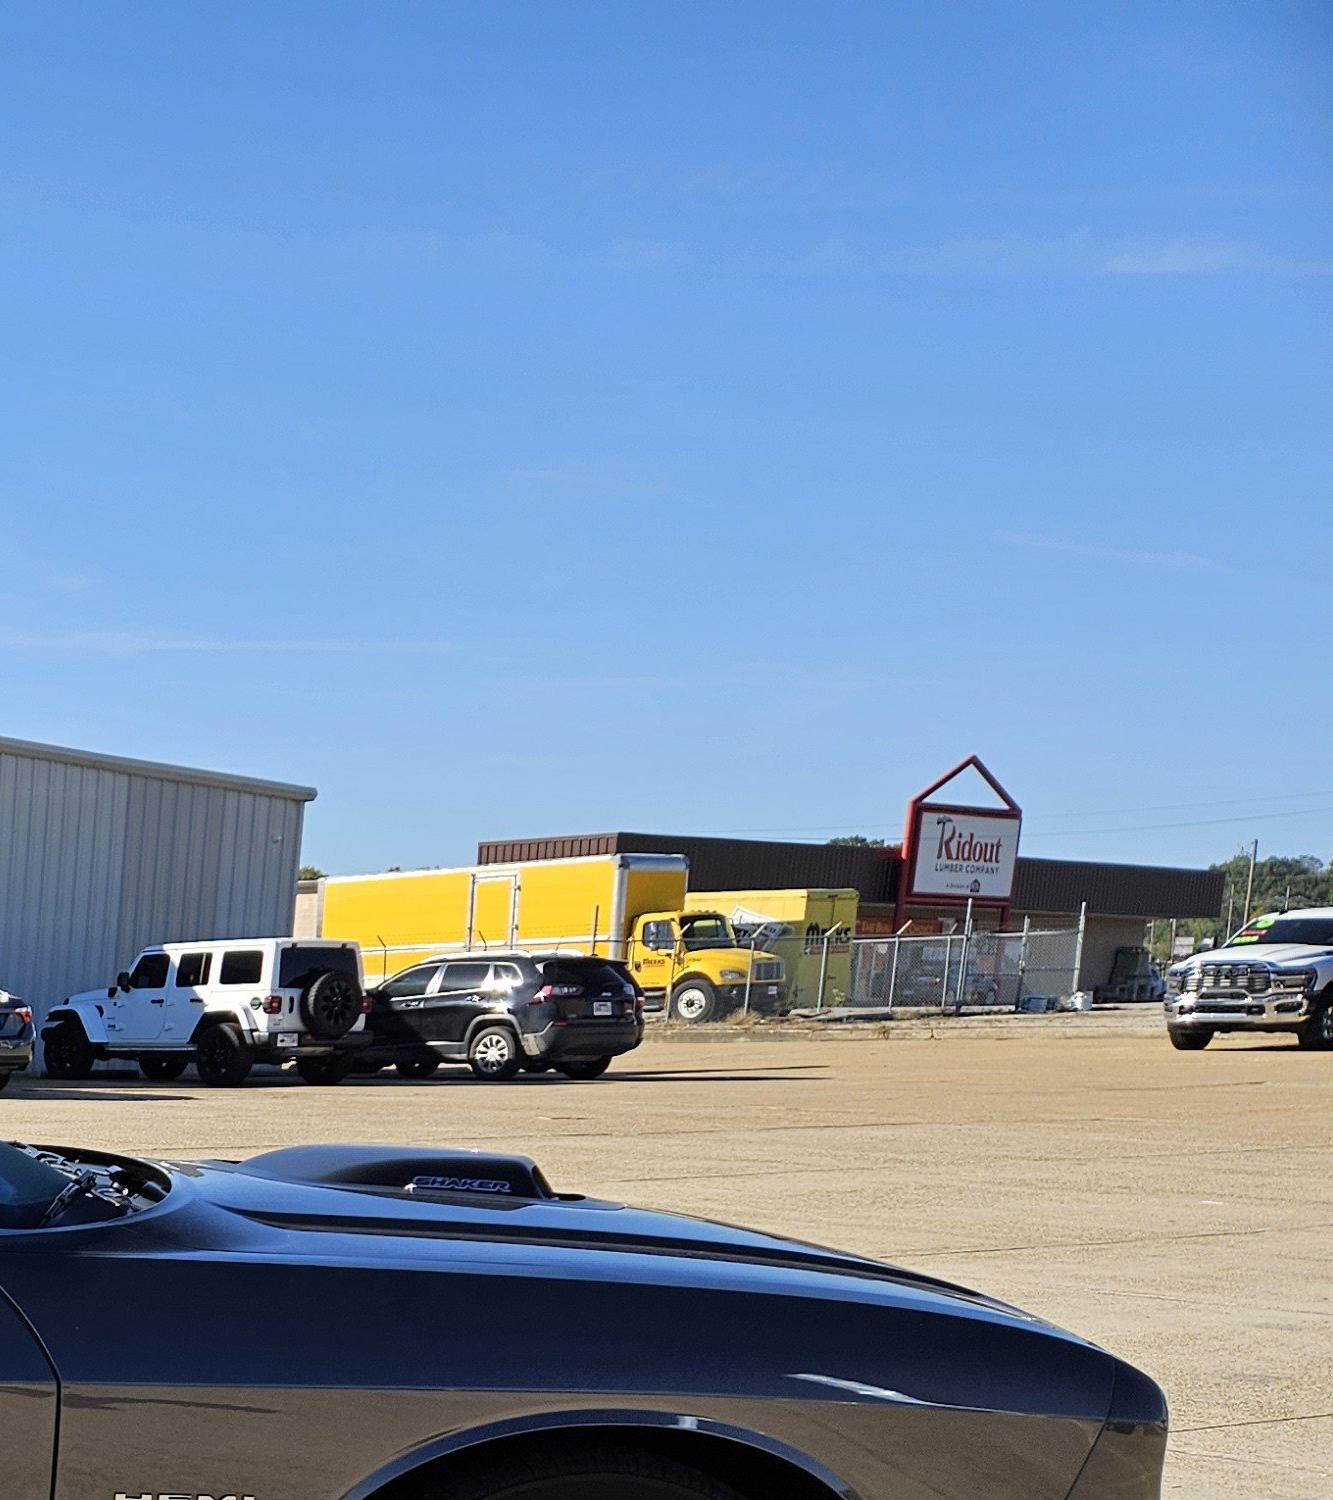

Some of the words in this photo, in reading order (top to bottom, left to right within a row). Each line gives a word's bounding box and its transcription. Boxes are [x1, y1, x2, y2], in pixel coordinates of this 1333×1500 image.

[936, 815, 1003, 864] Ridout
[935, 862, 964, 874] LUMBER
[965, 864, 1001, 875] COMPANY
[413, 1176, 512, 1192] SHAKER
